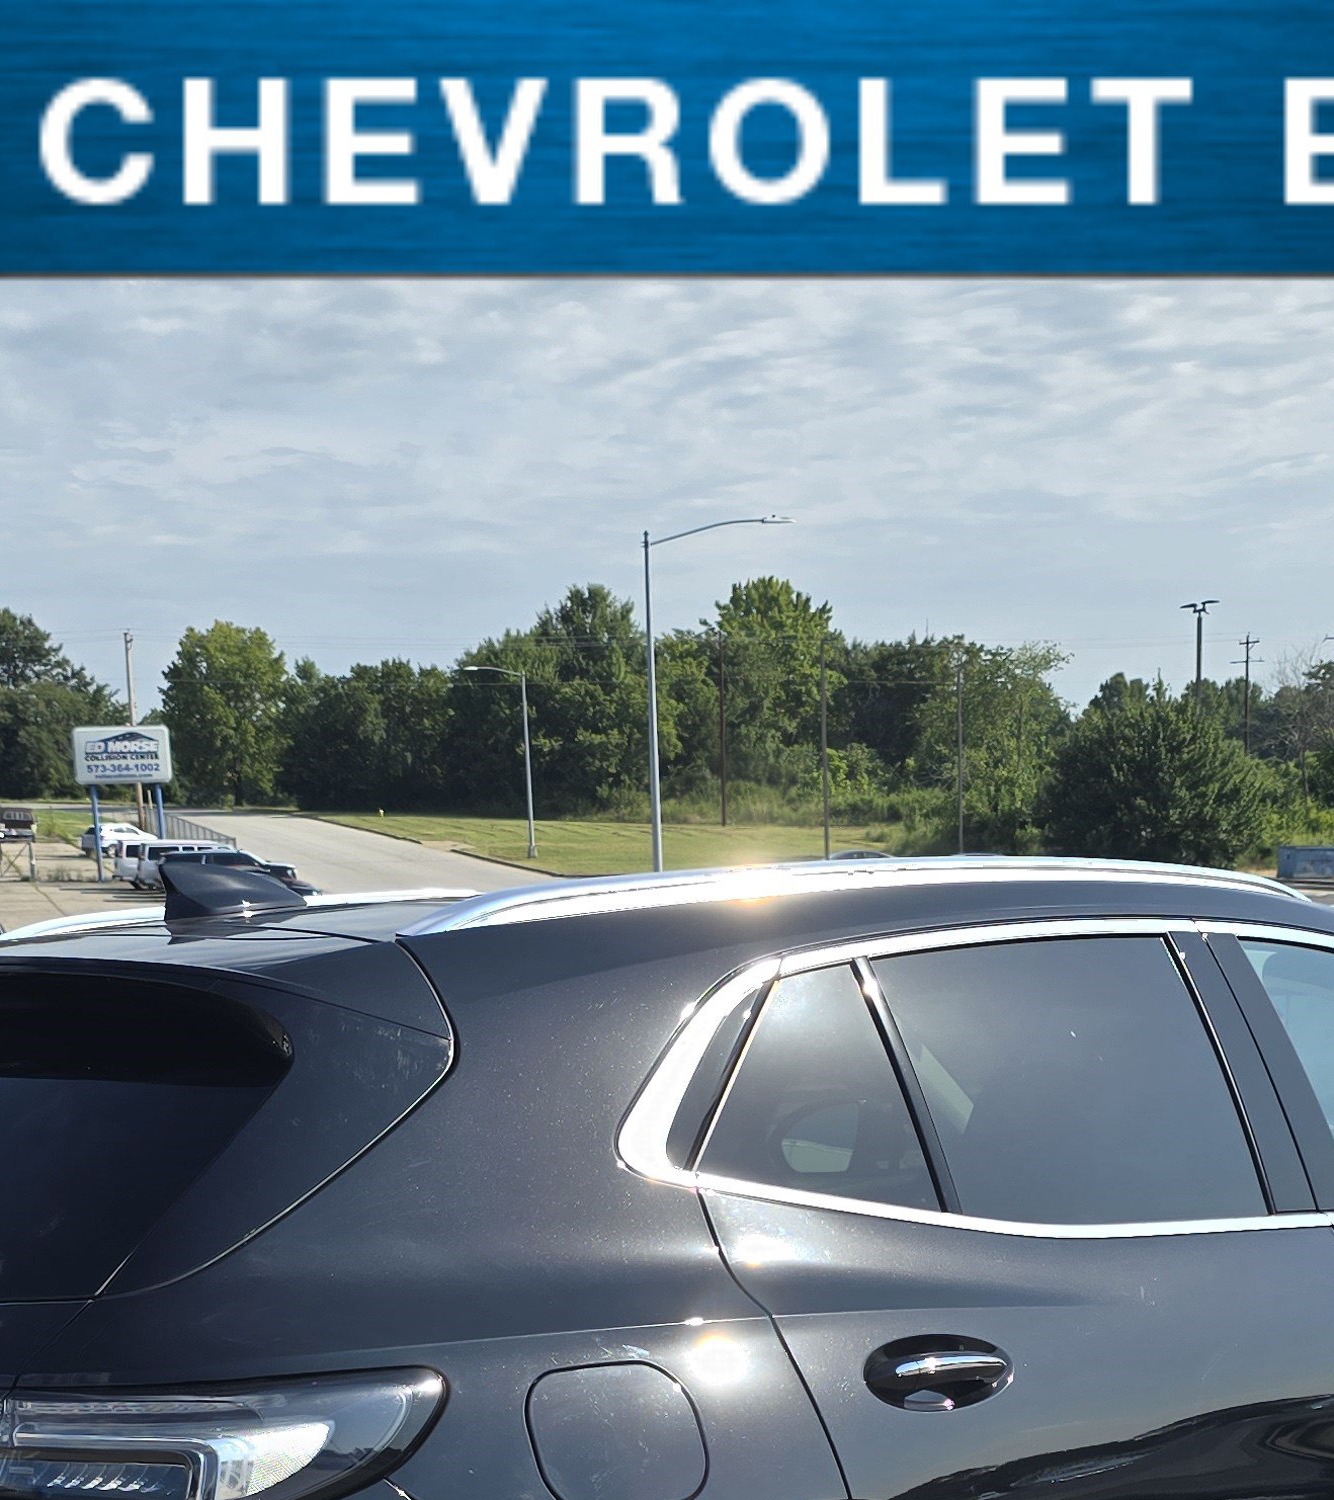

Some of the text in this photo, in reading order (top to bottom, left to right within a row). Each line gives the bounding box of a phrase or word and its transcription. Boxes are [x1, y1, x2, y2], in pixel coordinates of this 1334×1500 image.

[86, 741, 158, 753] ED MORSE
[87, 763, 160, 773] 573-364-1002
